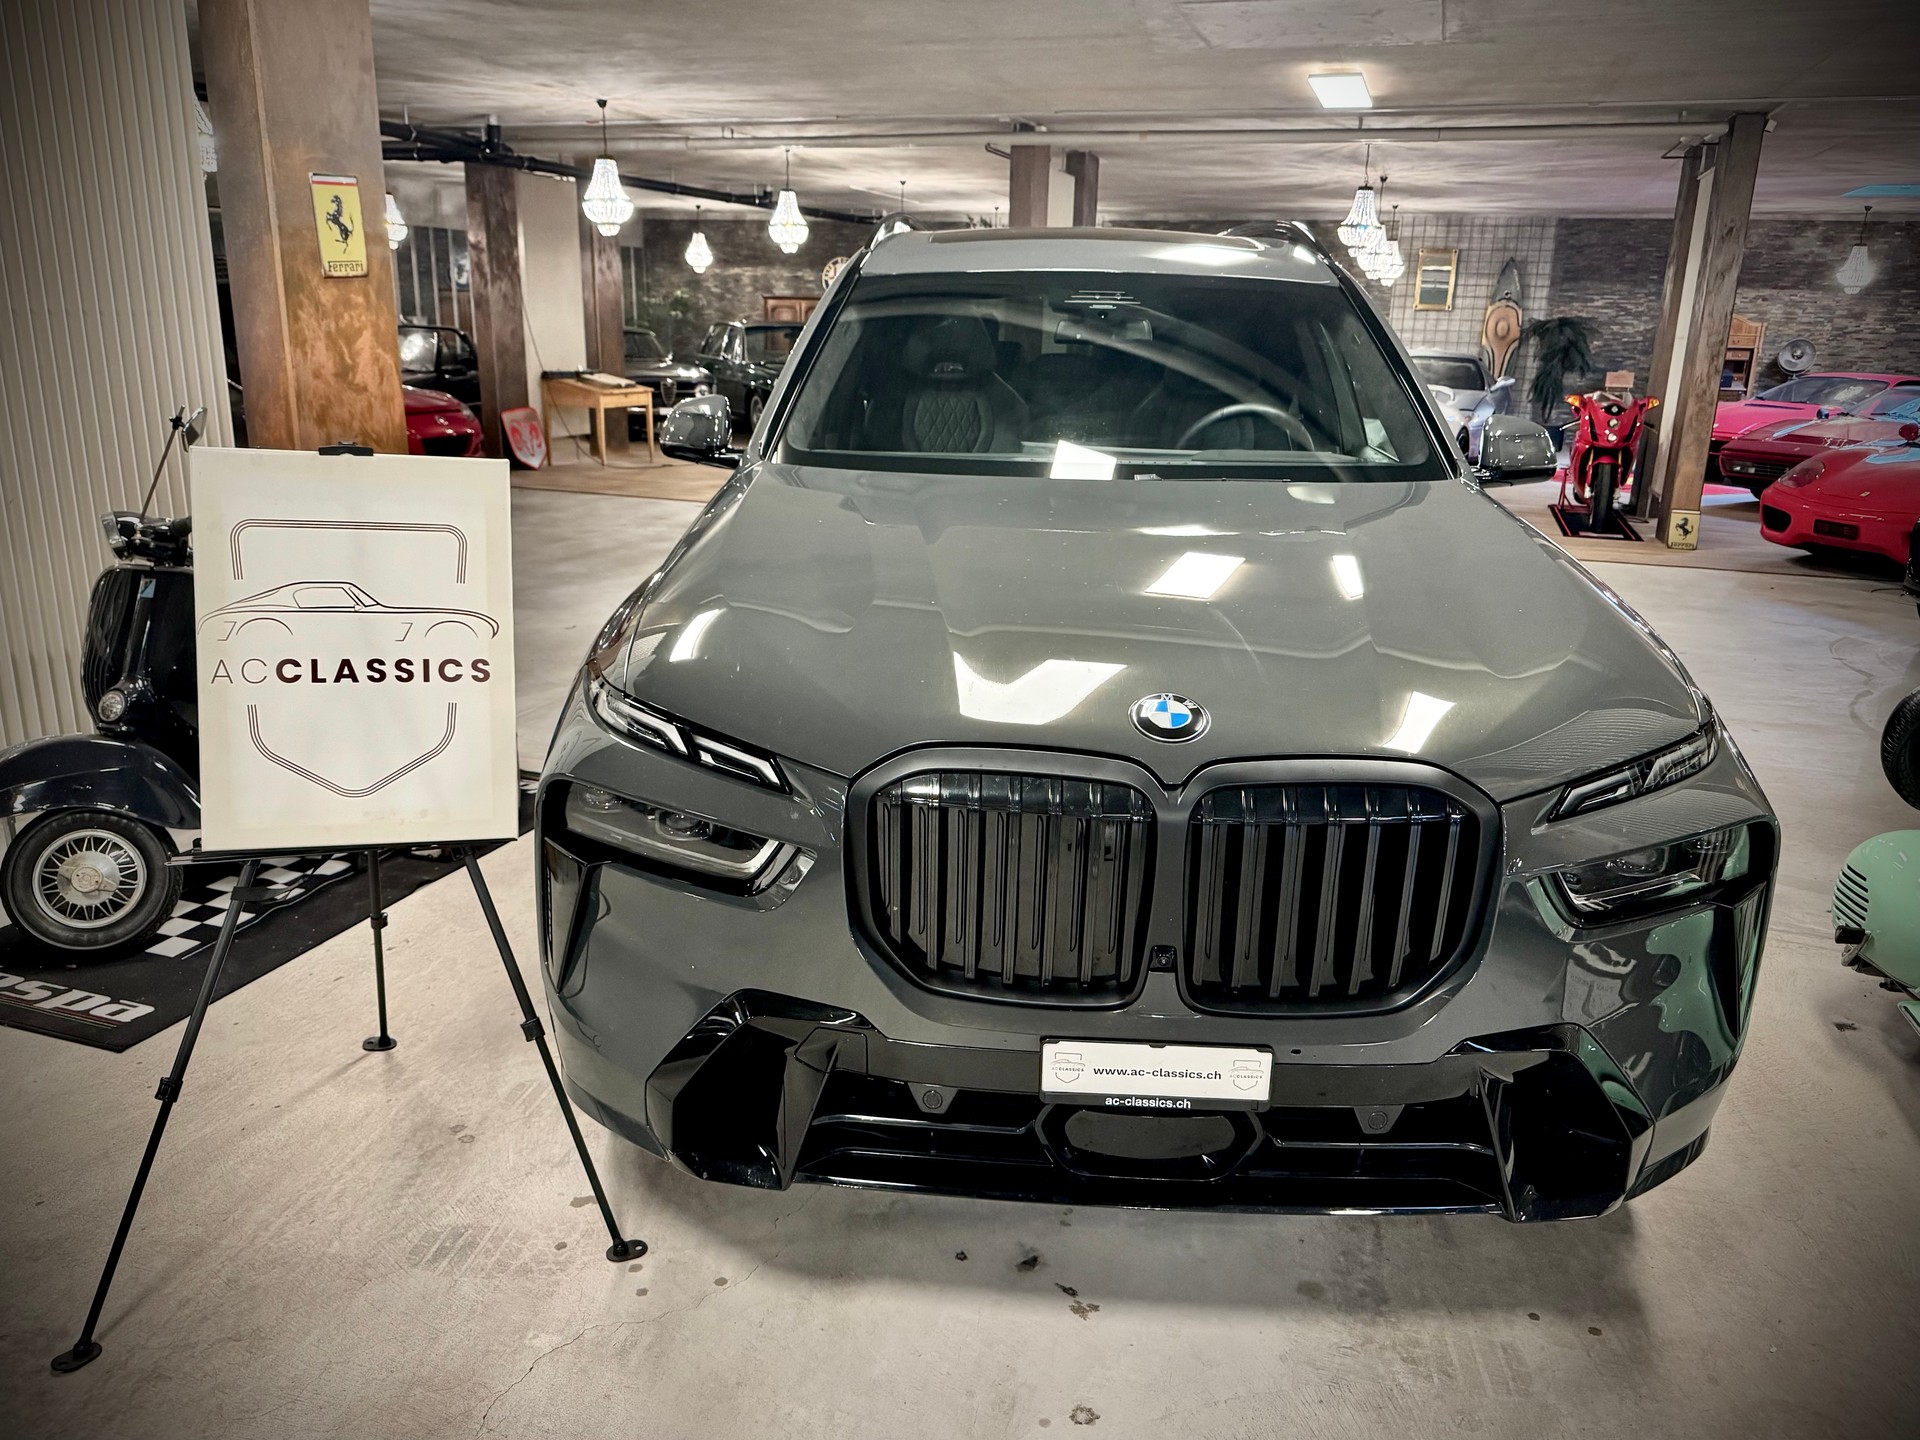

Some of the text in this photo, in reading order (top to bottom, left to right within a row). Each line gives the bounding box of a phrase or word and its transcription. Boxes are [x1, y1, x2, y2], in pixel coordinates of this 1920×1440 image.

[327, 260, 364, 273] Ferrari
[1093, 1066, 1222, 1080] www.ac-classics.ch
[1105, 1096, 1191, 1109] ac-classics.ch
